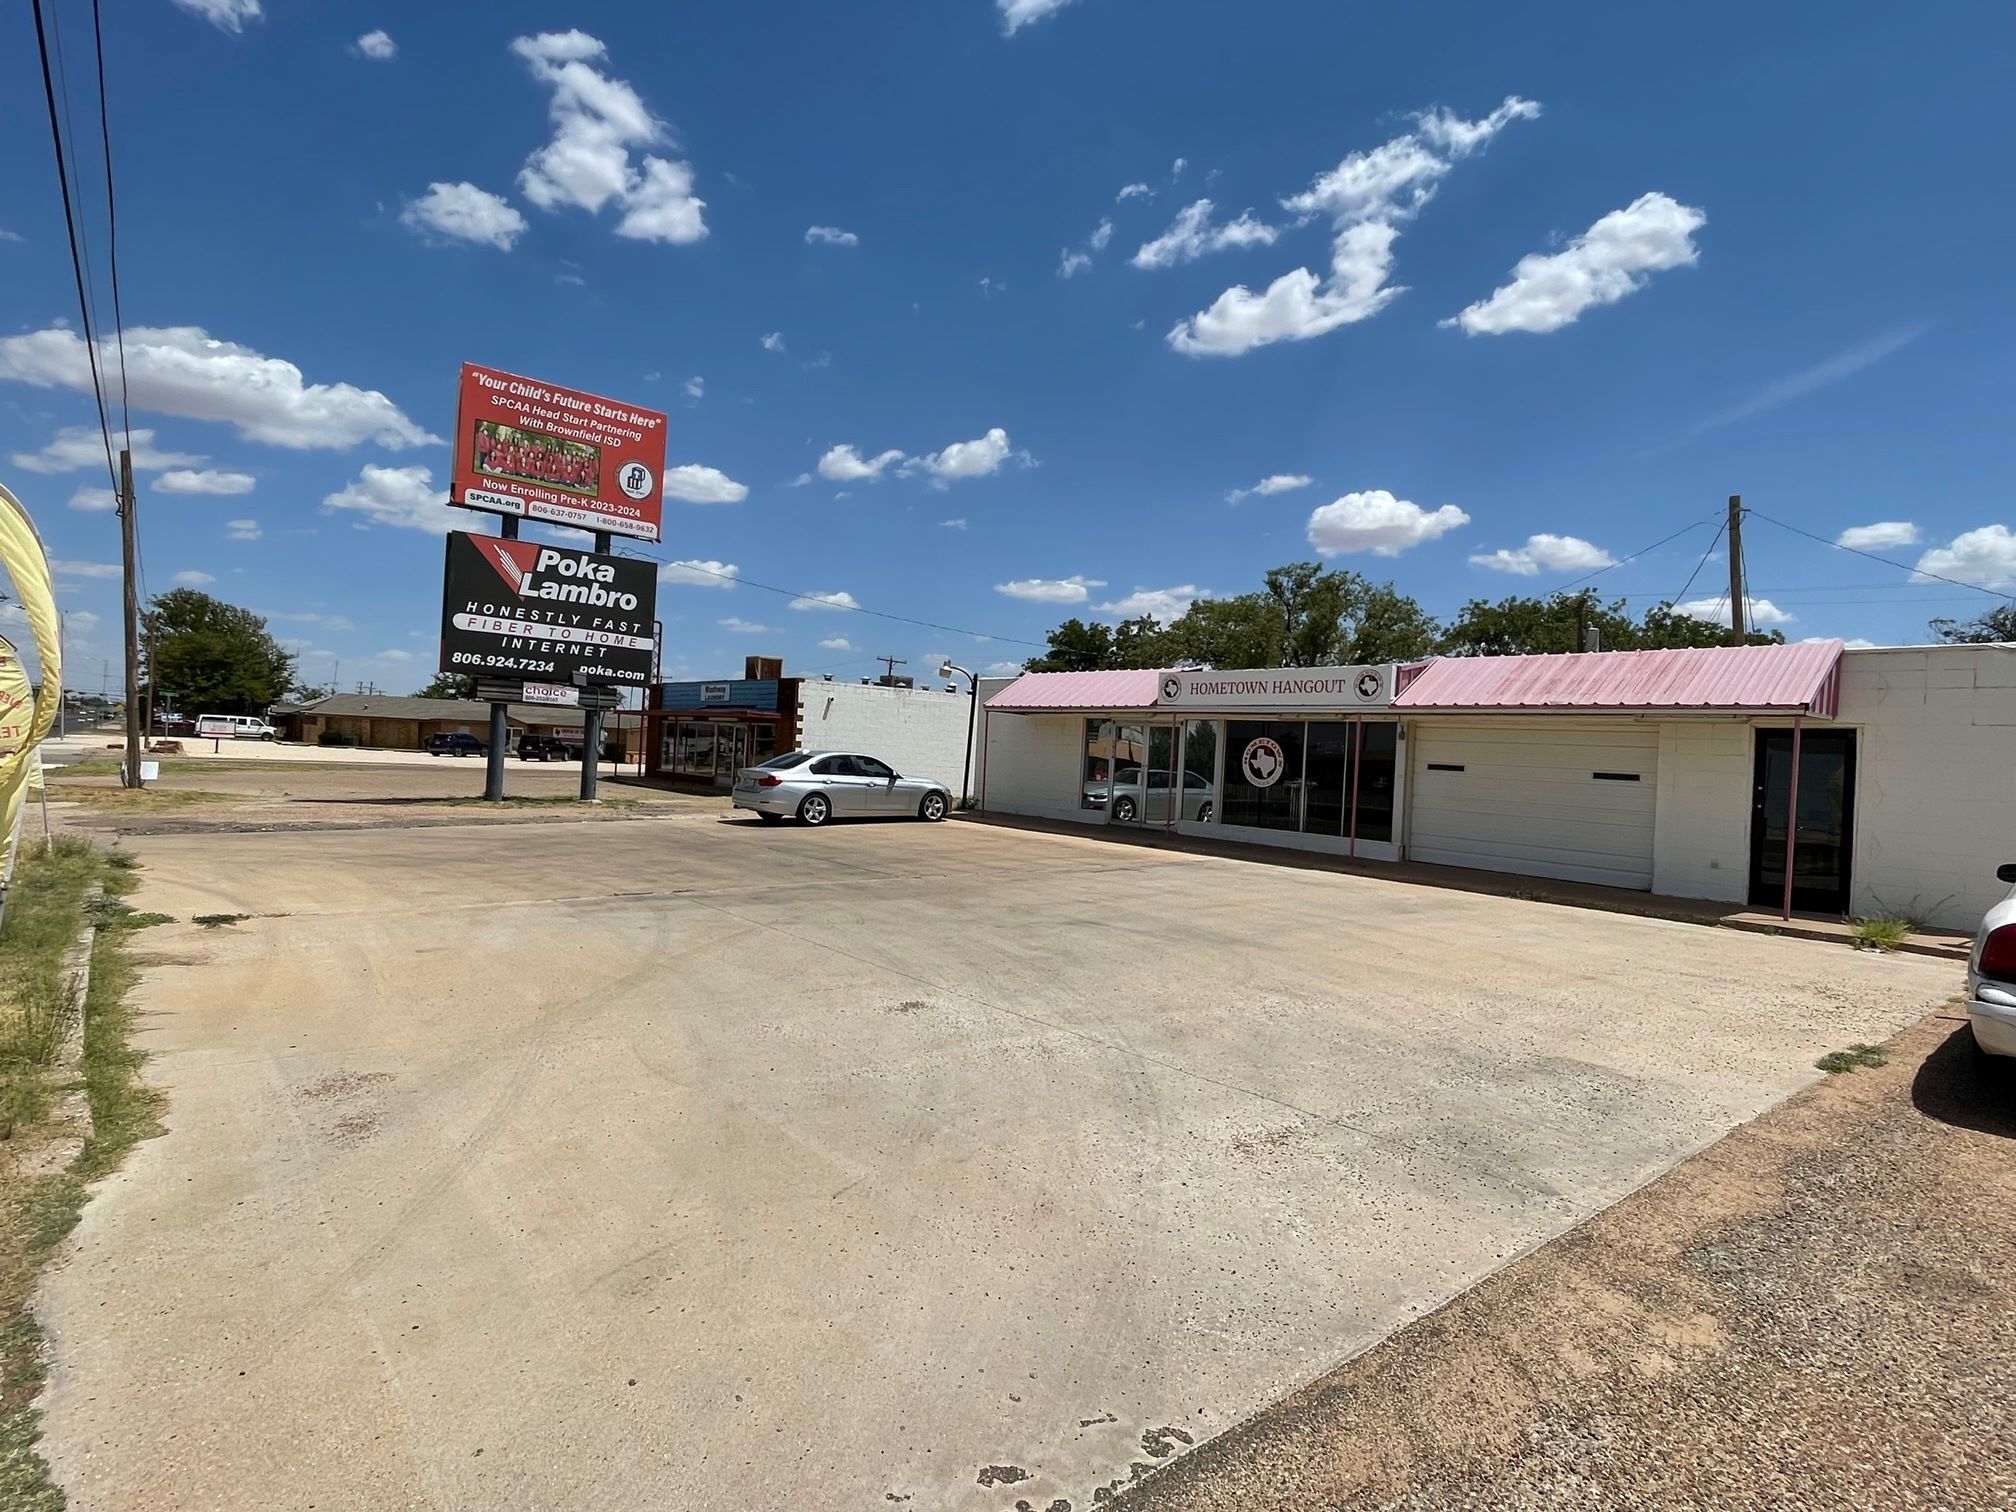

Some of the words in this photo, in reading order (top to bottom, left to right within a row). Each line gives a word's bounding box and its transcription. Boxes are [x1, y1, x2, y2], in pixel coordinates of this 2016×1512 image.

[491, 396, 530, 413] SPCAA
[532, 406, 560, 420] Head
[562, 412, 588, 426] Start
[590, 420, 642, 442] Partnering
[553, 393, 591, 412] Future
[594, 403, 628, 422] Starts
[520, 416, 544, 429] With
[546, 422, 602, 443] Brownfield
[604, 436, 622, 448] ISD
[470, 492, 521, 510] SPCAA.org
[482, 478, 508, 492] Now
[510, 484, 557, 504] Enrolling
[560, 494, 588, 508] Pre-K
[590, 500, 641, 518] 2023-2024
[532, 504, 586, 520] 806-637-0757
[596, 516, 654, 534] 1-800-658-9632
[536, 549, 616, 582] Poka
[518, 572, 638, 611] Lambro
[466, 601, 581, 625] HONESTLY
[592, 618, 642, 634] FAST
[467, 618, 534, 634] FIBER
[548, 628, 571, 638] TO
[585, 631, 638, 648] HOME
[502, 636, 608, 658] INTERNET
[452, 652, 555, 672] 806.924.7234
[580, 665, 644, 680] poka.com
[526, 686, 567, 697] choice
[1190, 680, 1268, 695] HOMETOWN
[1272, 680, 1346, 694] HANGOUT
